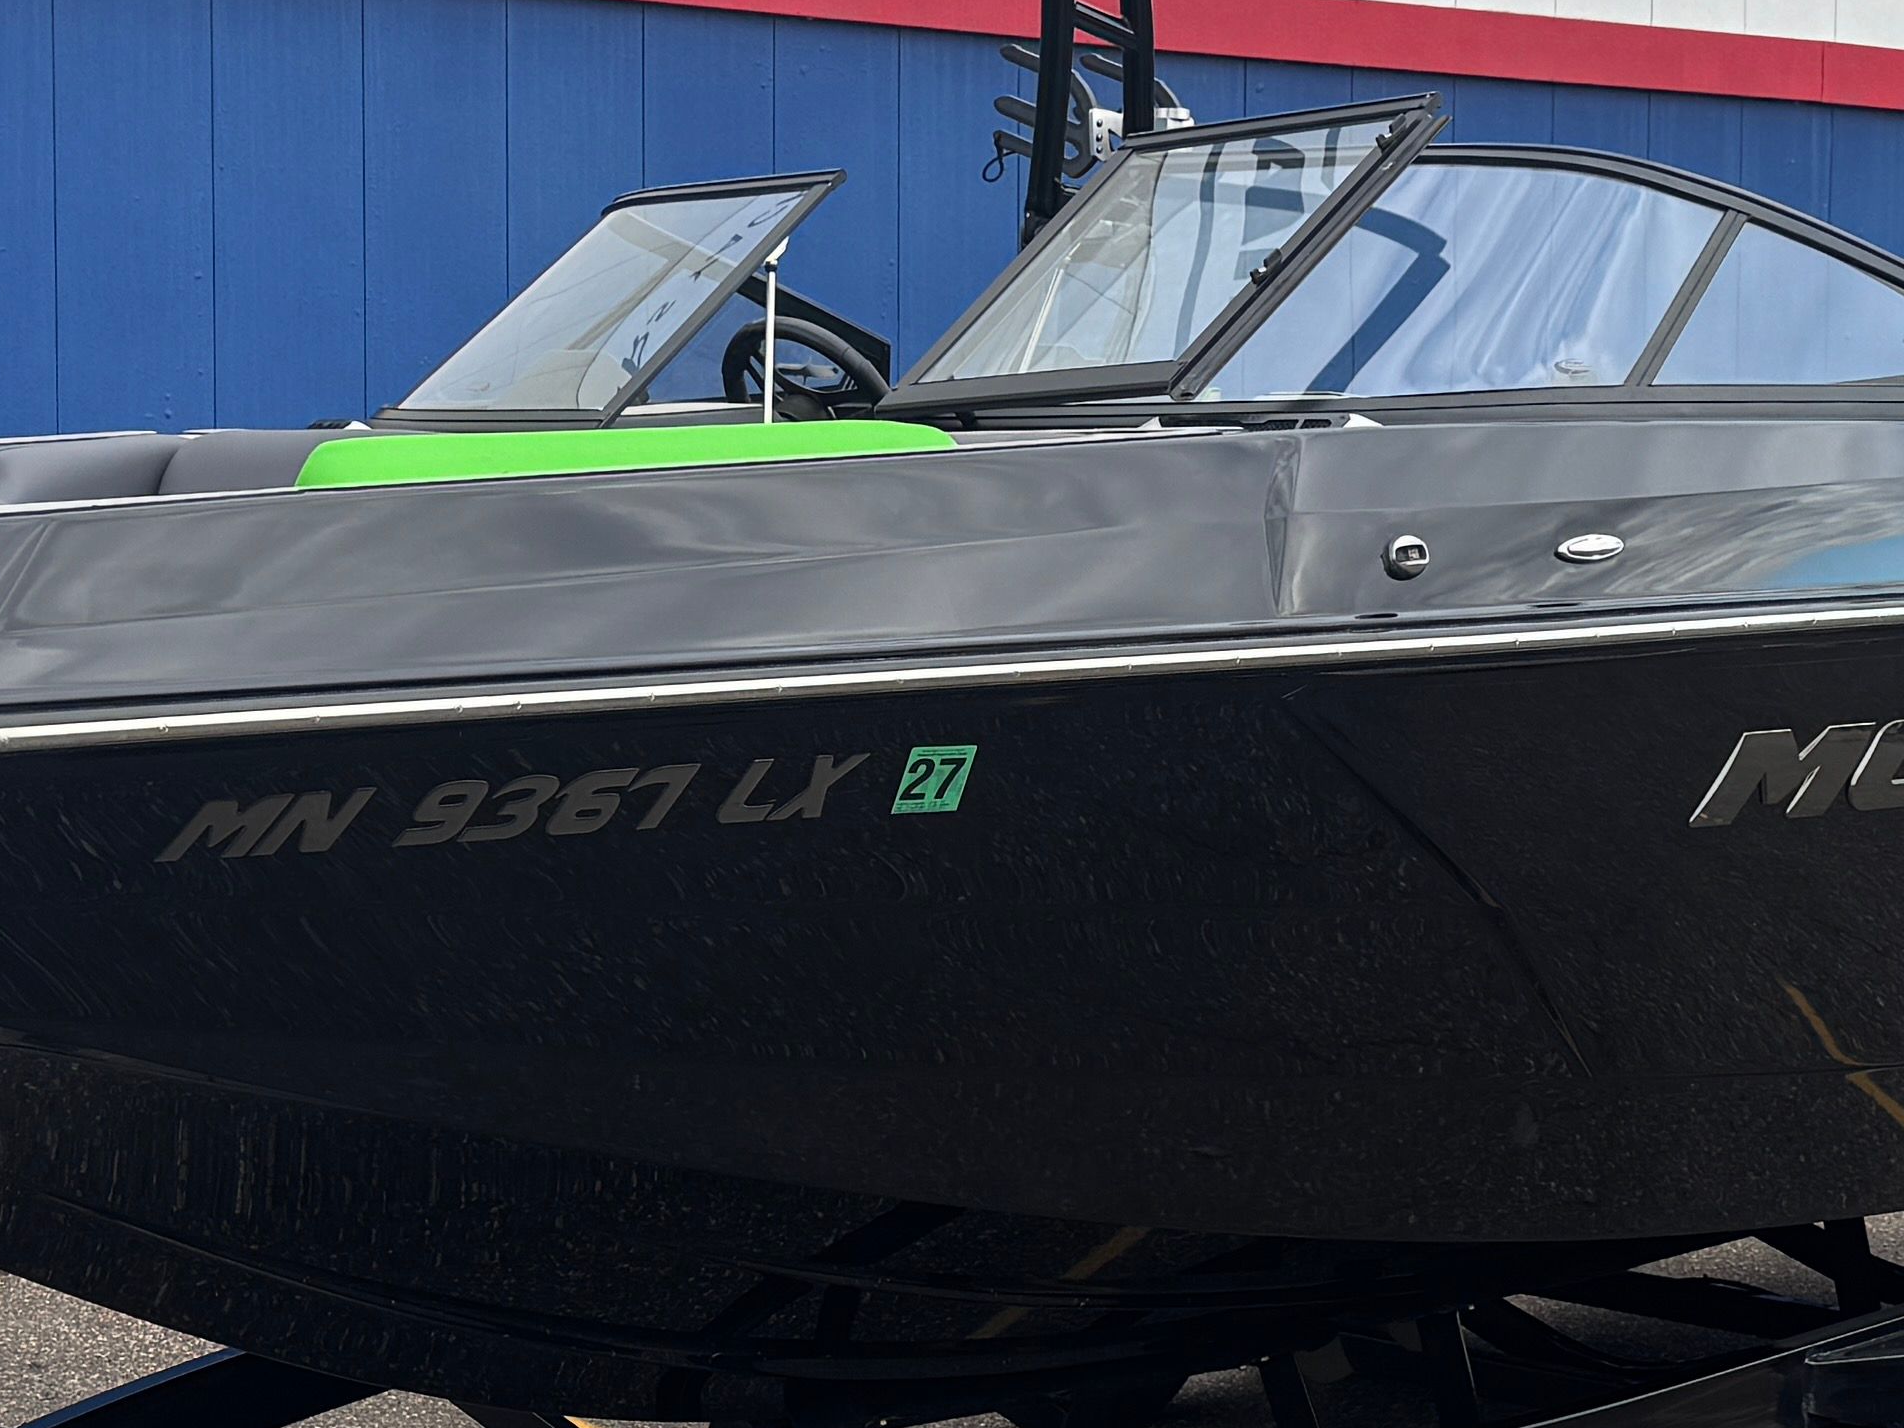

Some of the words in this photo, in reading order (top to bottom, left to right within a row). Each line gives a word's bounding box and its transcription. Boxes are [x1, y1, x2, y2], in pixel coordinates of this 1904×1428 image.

[153, 787, 377, 862] MN
[392, 763, 702, 847] 9367
[716, 752, 871, 824] LX
[898, 757, 968, 801] 27
